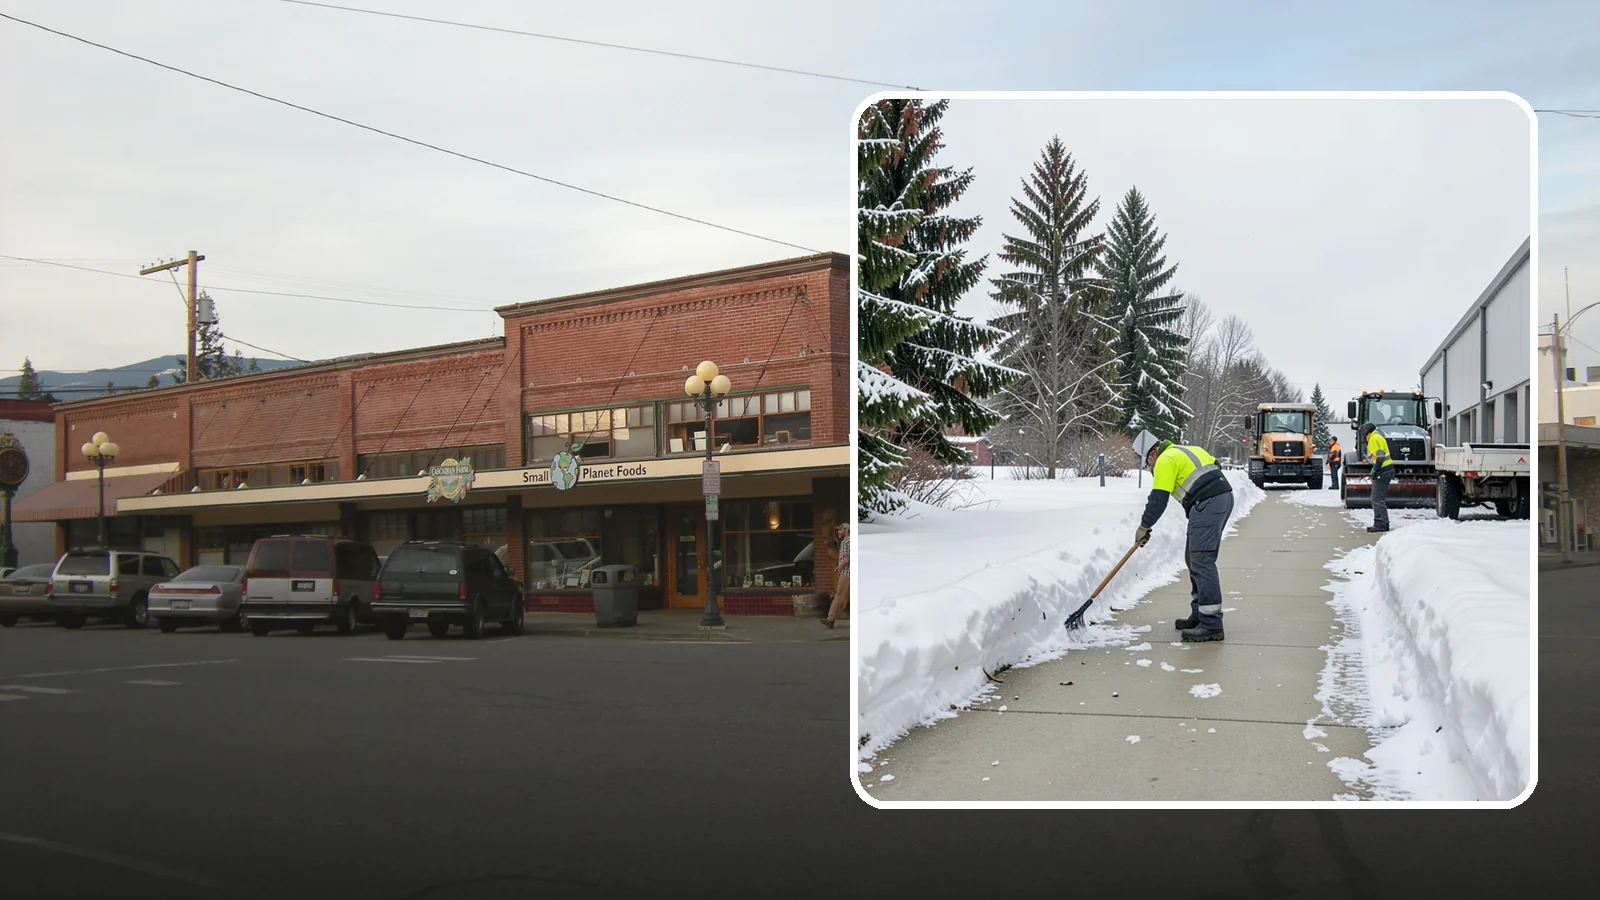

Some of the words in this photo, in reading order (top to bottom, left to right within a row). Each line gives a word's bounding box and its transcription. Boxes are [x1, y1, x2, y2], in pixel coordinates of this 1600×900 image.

[523, 471, 549, 483] Small
[582, 467, 614, 479] Planet
[616, 464, 647, 477] Foods
